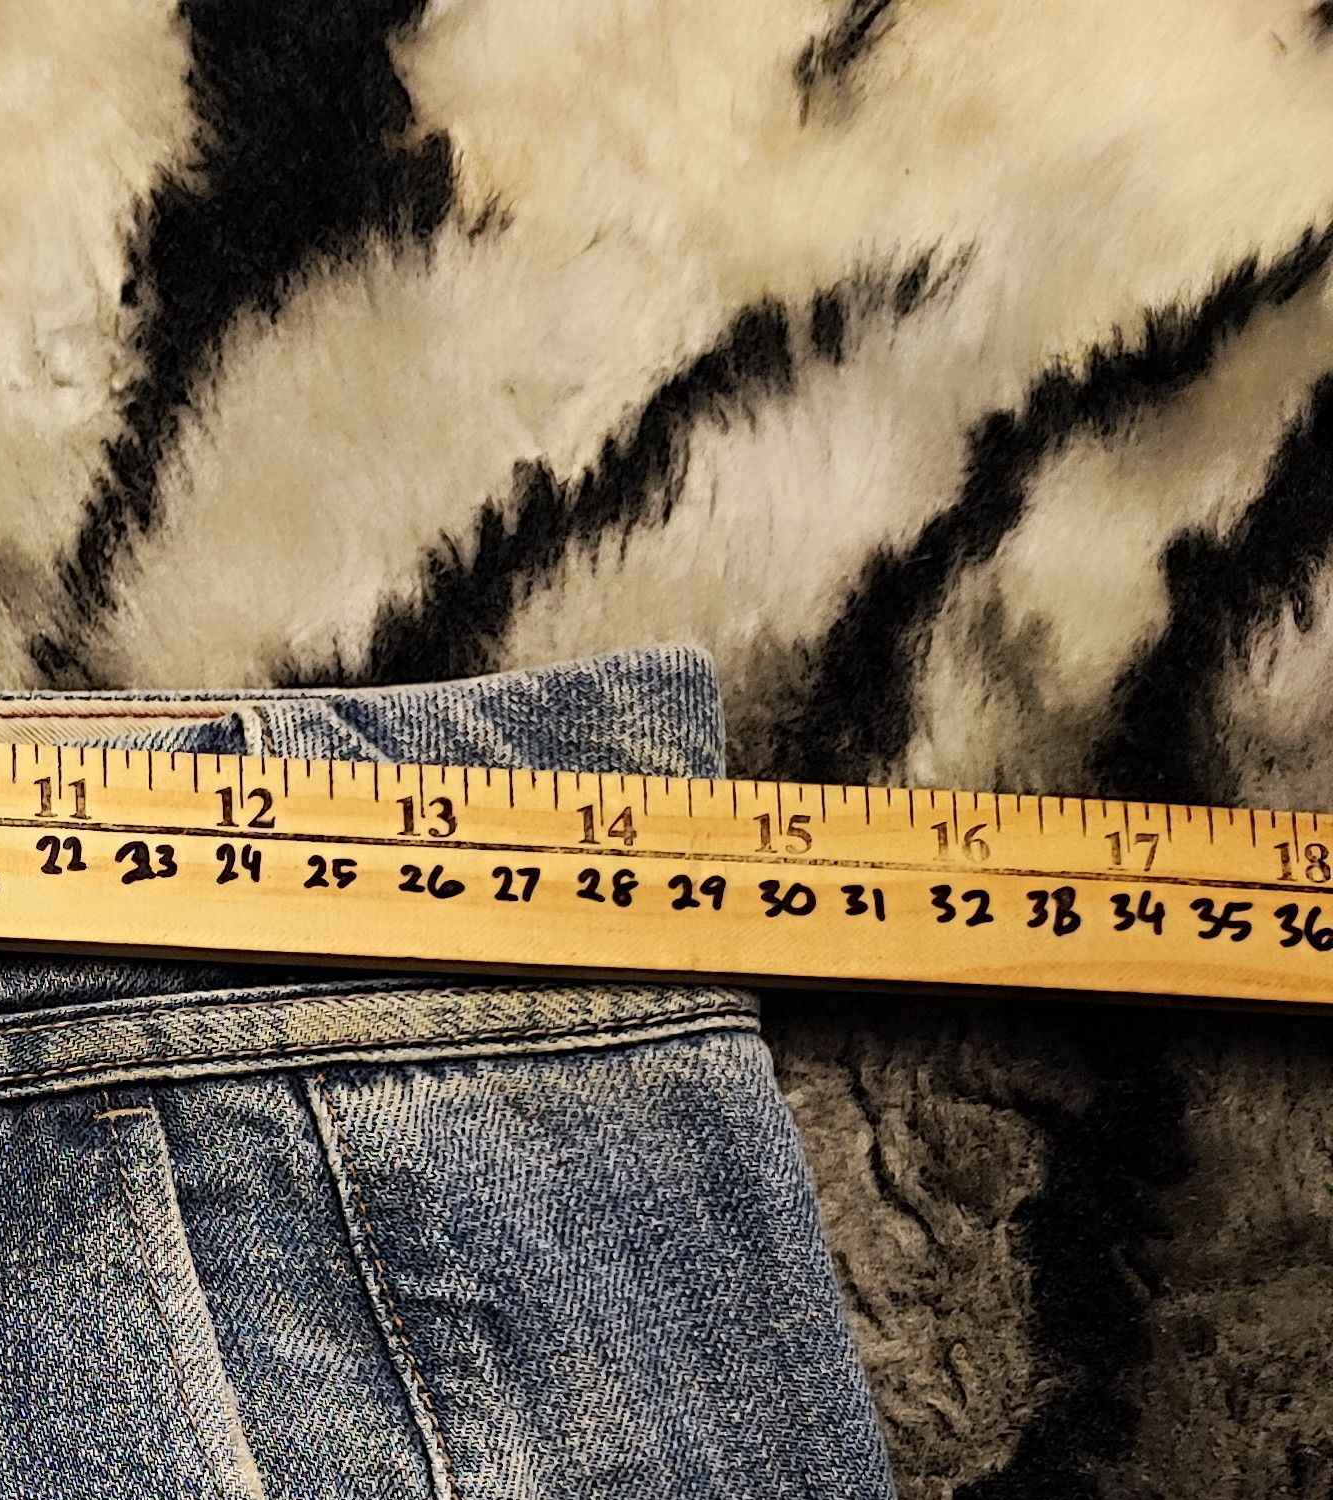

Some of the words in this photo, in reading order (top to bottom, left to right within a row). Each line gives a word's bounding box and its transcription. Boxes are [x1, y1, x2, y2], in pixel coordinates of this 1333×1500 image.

[33, 777, 92, 820] 11
[216, 786, 276, 829] 12
[397, 796, 457, 838] 13
[576, 805, 637, 847] 14
[753, 813, 813, 855] 15
[931, 821, 991, 863] 16
[1104, 831, 1160, 872] 17
[1274, 842, 1331, 883] 18
[36, 835, 87, 874] 22
[216, 843, 262, 885] 24
[304, 855, 357, 890] 25
[398, 865, 465, 898] 26
[493, 866, 540, 903] 27
[577, 868, 638, 907] 28
[668, 874, 727, 911] 29
[759, 879, 816, 918] 30
[840, 884, 885, 922] 31
[930, 884, 994, 927] 32
[1110, 890, 1166, 935] 34
[1190, 897, 1253, 942] 35
[1274, 903, 1333, 951] 36
